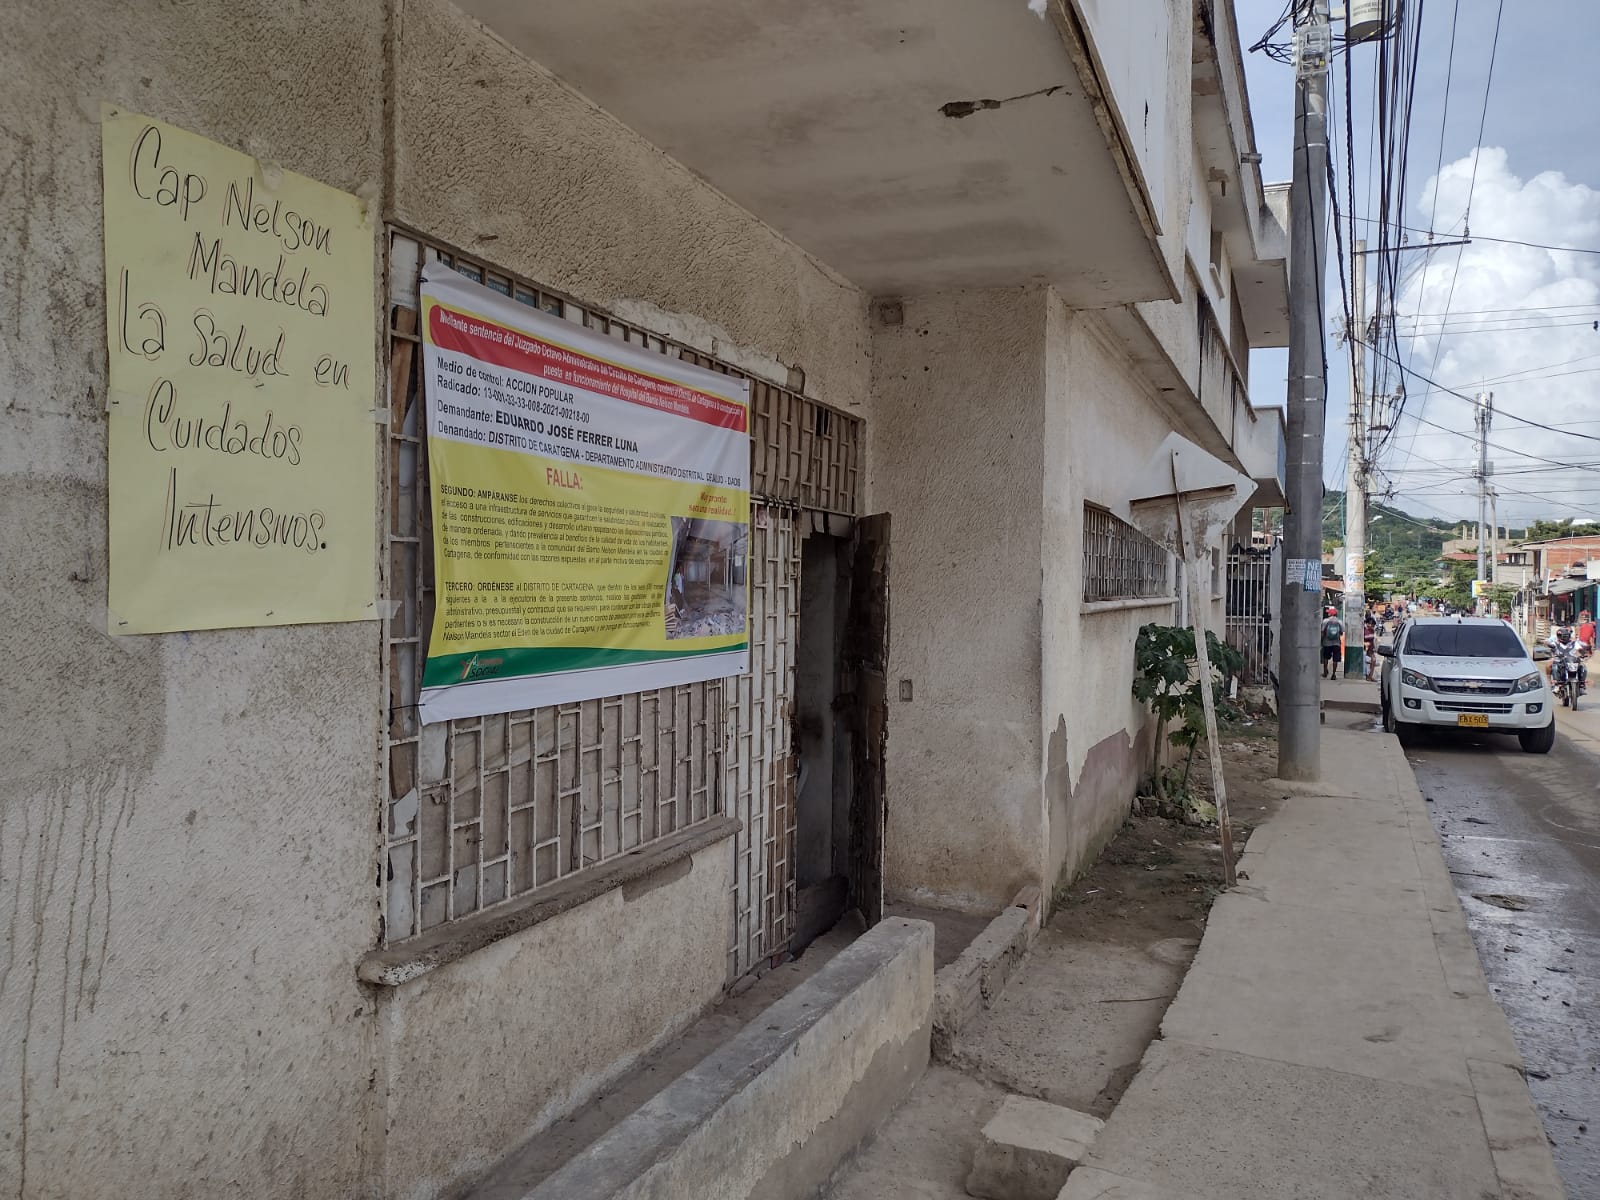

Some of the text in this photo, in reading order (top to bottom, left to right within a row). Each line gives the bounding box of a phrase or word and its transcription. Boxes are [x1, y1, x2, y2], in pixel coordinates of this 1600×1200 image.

[130, 124, 332, 256] Cap Nelson
[187, 231, 331, 317] Mandela
[119, 265, 350, 390] La Salud en
[469, 324, 503, 343] sentencia
[503, 332, 515, 346] del
[515, 335, 541, 354] Juzgado
[437, 356, 574, 404] Medio de control: ACCION POPULAR
[437, 374, 481, 397] Radicado:
[143, 376, 303, 466] Cuidados
[437, 399, 638, 453] Demandante: EDUARDO JOSÉ FERRER LUNA
[488, 430, 527, 449] DISTRITO
[528, 439, 538, 451] DE
[539, 441, 580, 460] CARATGENA
[441, 484, 476, 498] SEGUNDO:
[519, 495, 529, 504] los
[546, 466, 583, 490] FALLA:
[159, 466, 327, 555] Intensivos.
[523, 582, 550, 592] DISTRITO
[551, 583, 560, 592] DE
